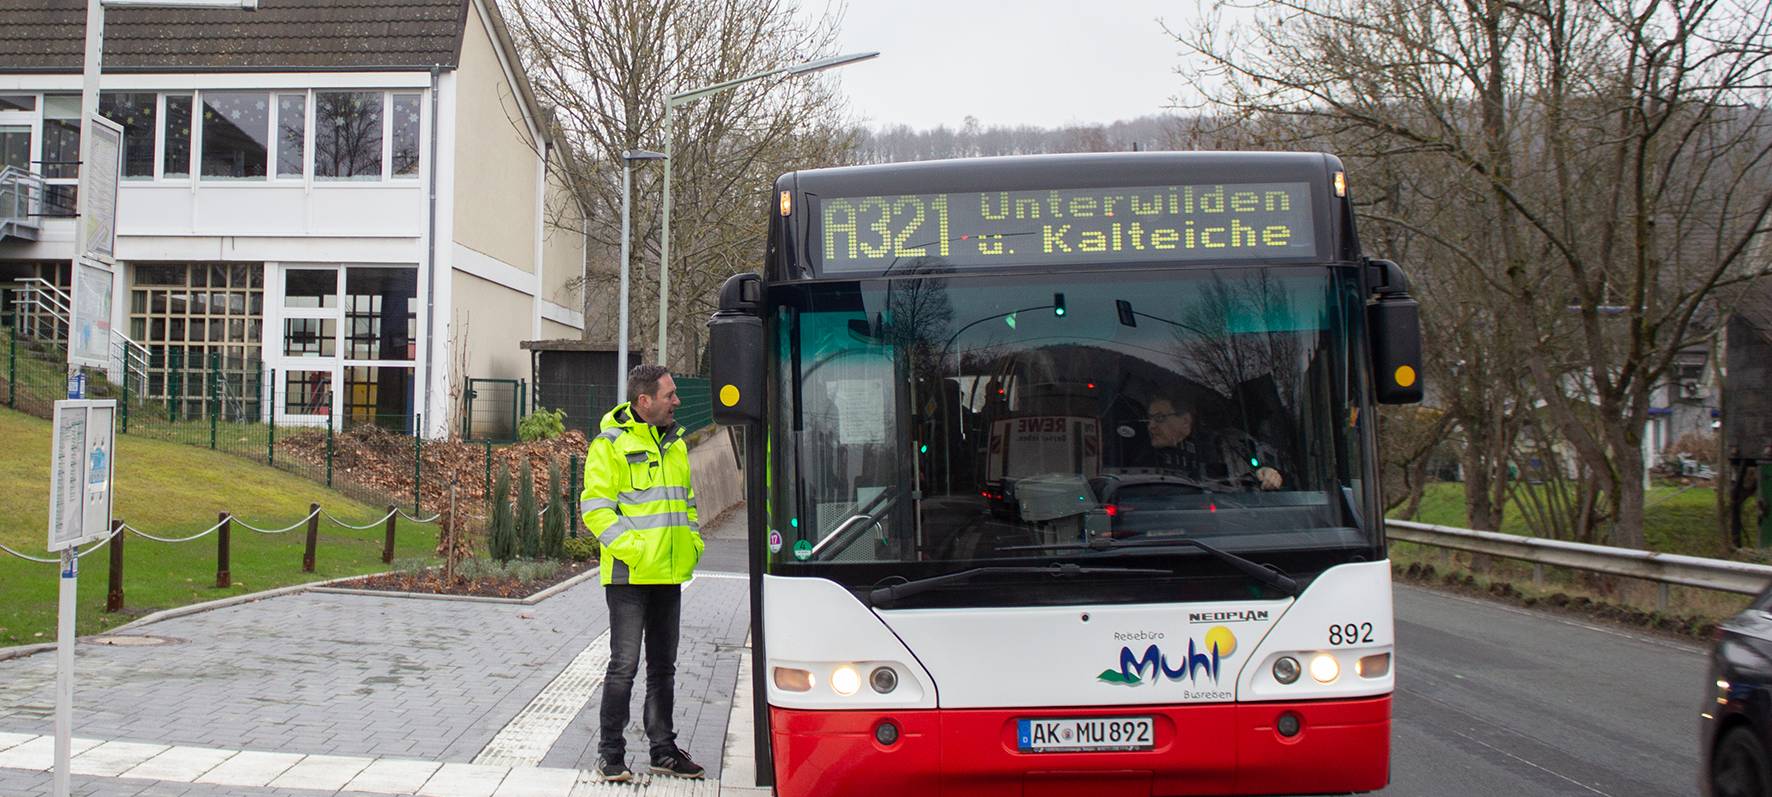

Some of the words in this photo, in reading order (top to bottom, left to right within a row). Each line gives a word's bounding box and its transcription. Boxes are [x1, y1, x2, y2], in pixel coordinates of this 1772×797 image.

[980, 185, 1290, 220] Unterwilden
[825, 194, 949, 259] A321
[1043, 219, 1291, 253] Kalteiche
[1189, 611, 1268, 623] NEOPLAN
[1329, 622, 1374, 645] 892
[1184, 690, 1232, 699] Busreisen
[1033, 723, 1060, 743] AK
